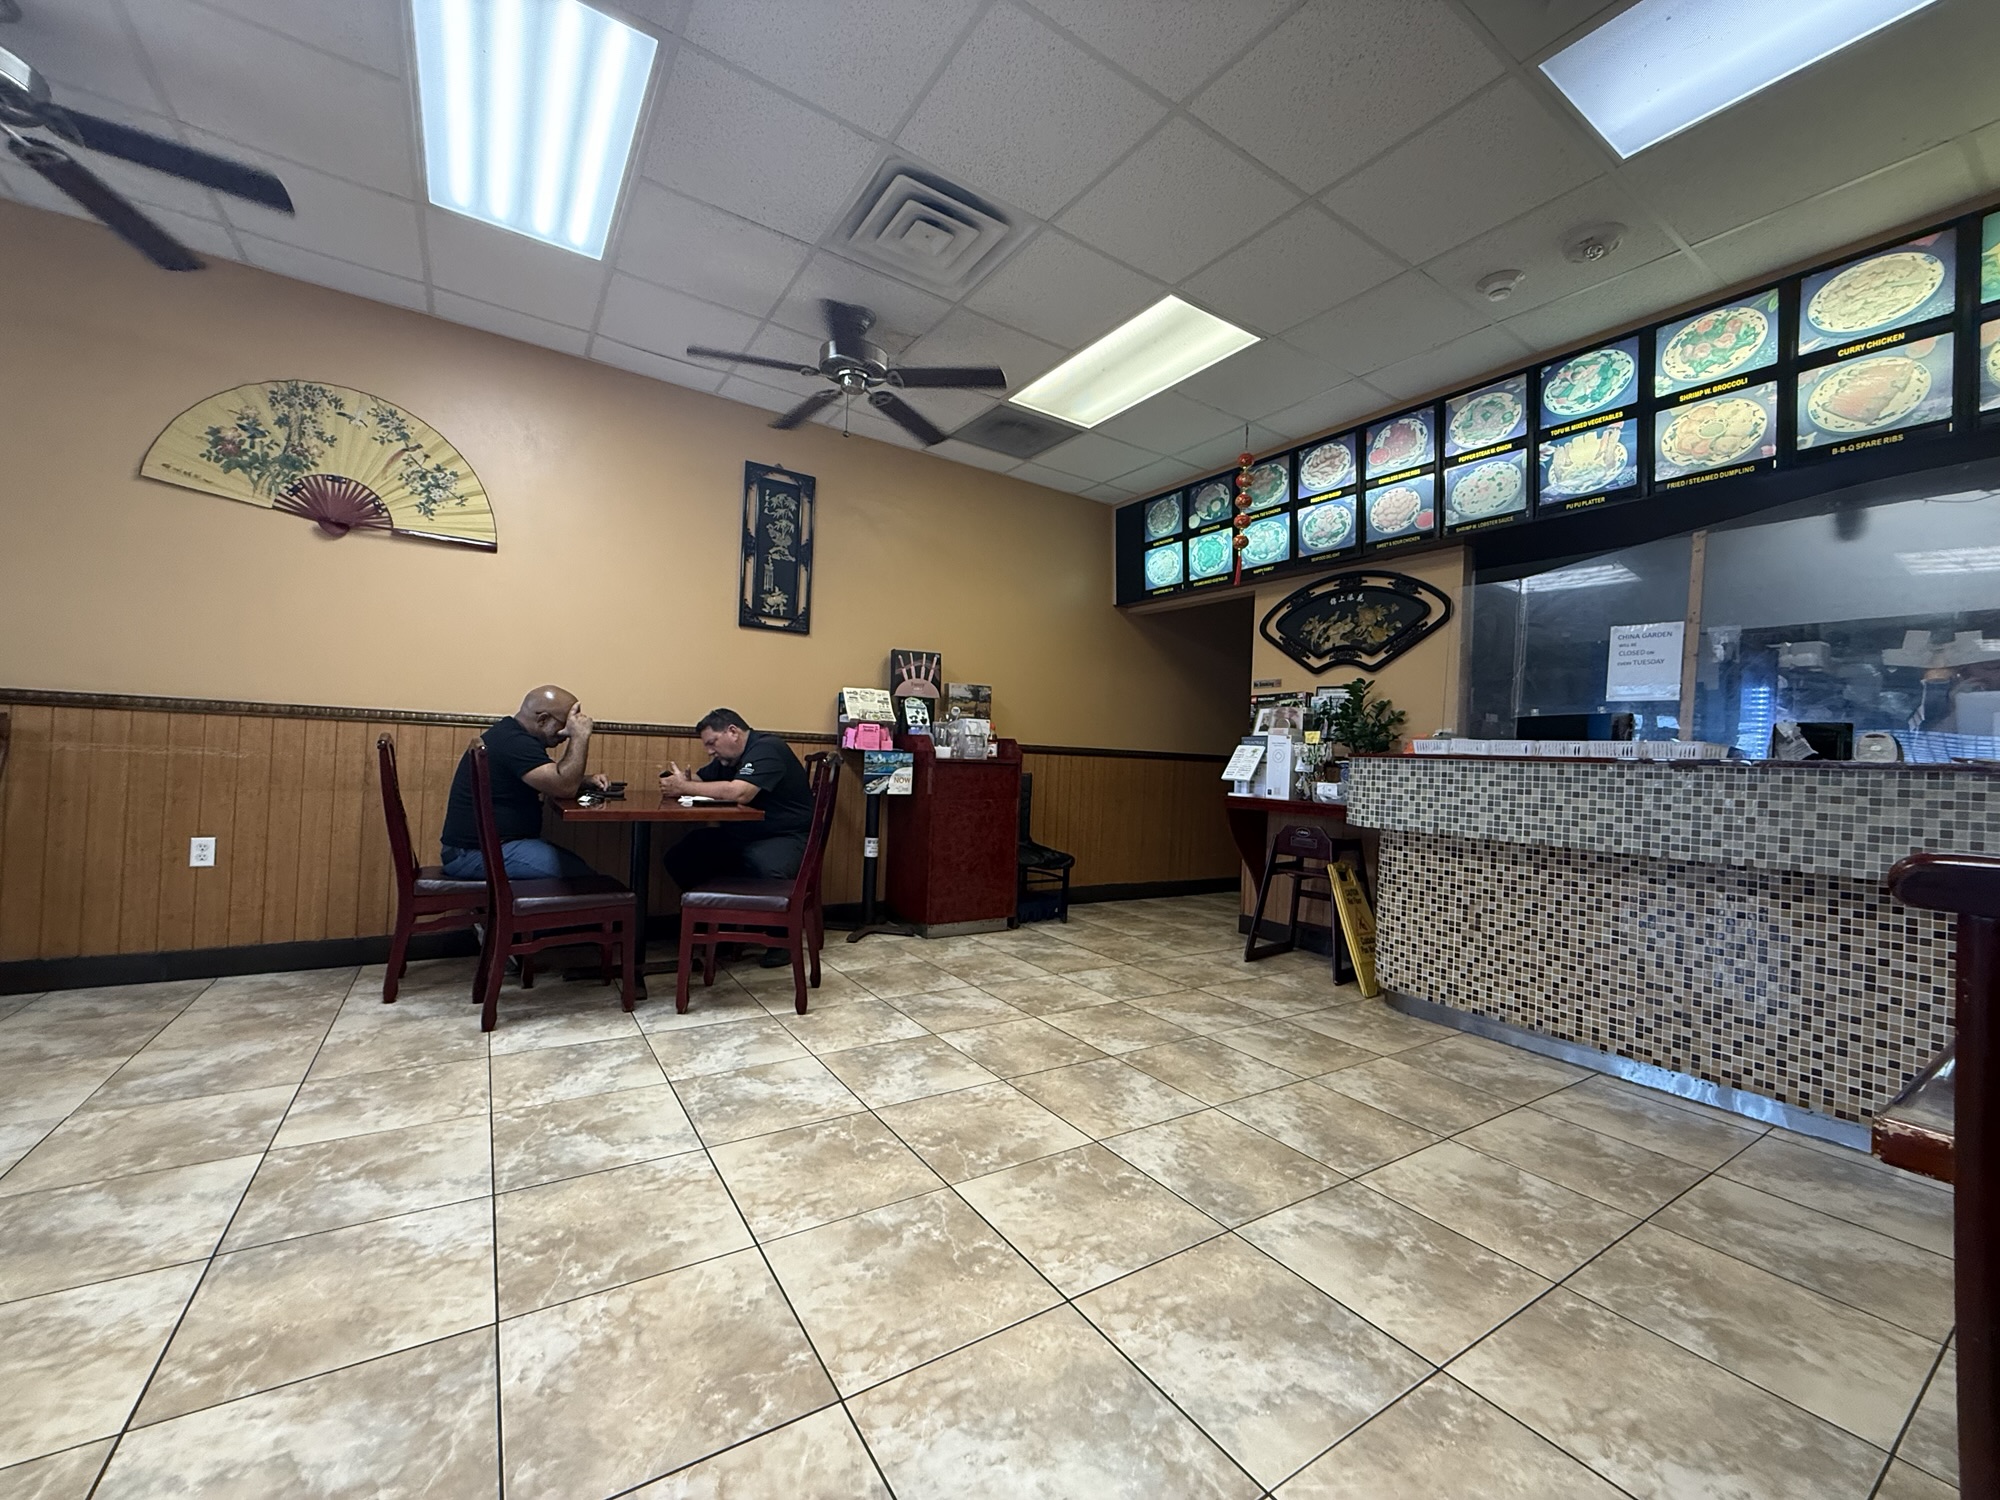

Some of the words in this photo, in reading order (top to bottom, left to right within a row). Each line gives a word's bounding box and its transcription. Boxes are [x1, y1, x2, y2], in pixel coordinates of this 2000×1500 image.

[1837, 343, 1866, 357] CURRY
[1866, 332, 1906, 349] CHICKEN
[1679, 389, 1704, 402] SHRIMP
[1712, 377, 1748, 394] BROCCOLI
[1551, 428, 1565, 436] TOFU
[1571, 421, 1588, 430] MIXED
[1588, 411, 1624, 426] VEGETABLES
[1831, 444, 1855, 455] B-B-Q
[1855, 438, 1882, 451] SPARE
[1883, 433, 1905, 444] RIBS
[1458, 453, 1476, 463] PEPPER
[1666, 480, 1685, 489] FRIED
[1689, 473, 1719, 485] STEAMED
[1720, 465, 1755, 479] DUMPLING
[1581, 496, 1606, 507] PLATTER
[1477, 518, 1498, 528] LOBSTER
[1617, 633, 1640, 641] CHINA
[1641, 631, 1673, 639] GARDEN
[1633, 658, 1665, 666] TUESDAY
[893, 776, 911, 784] NOW
